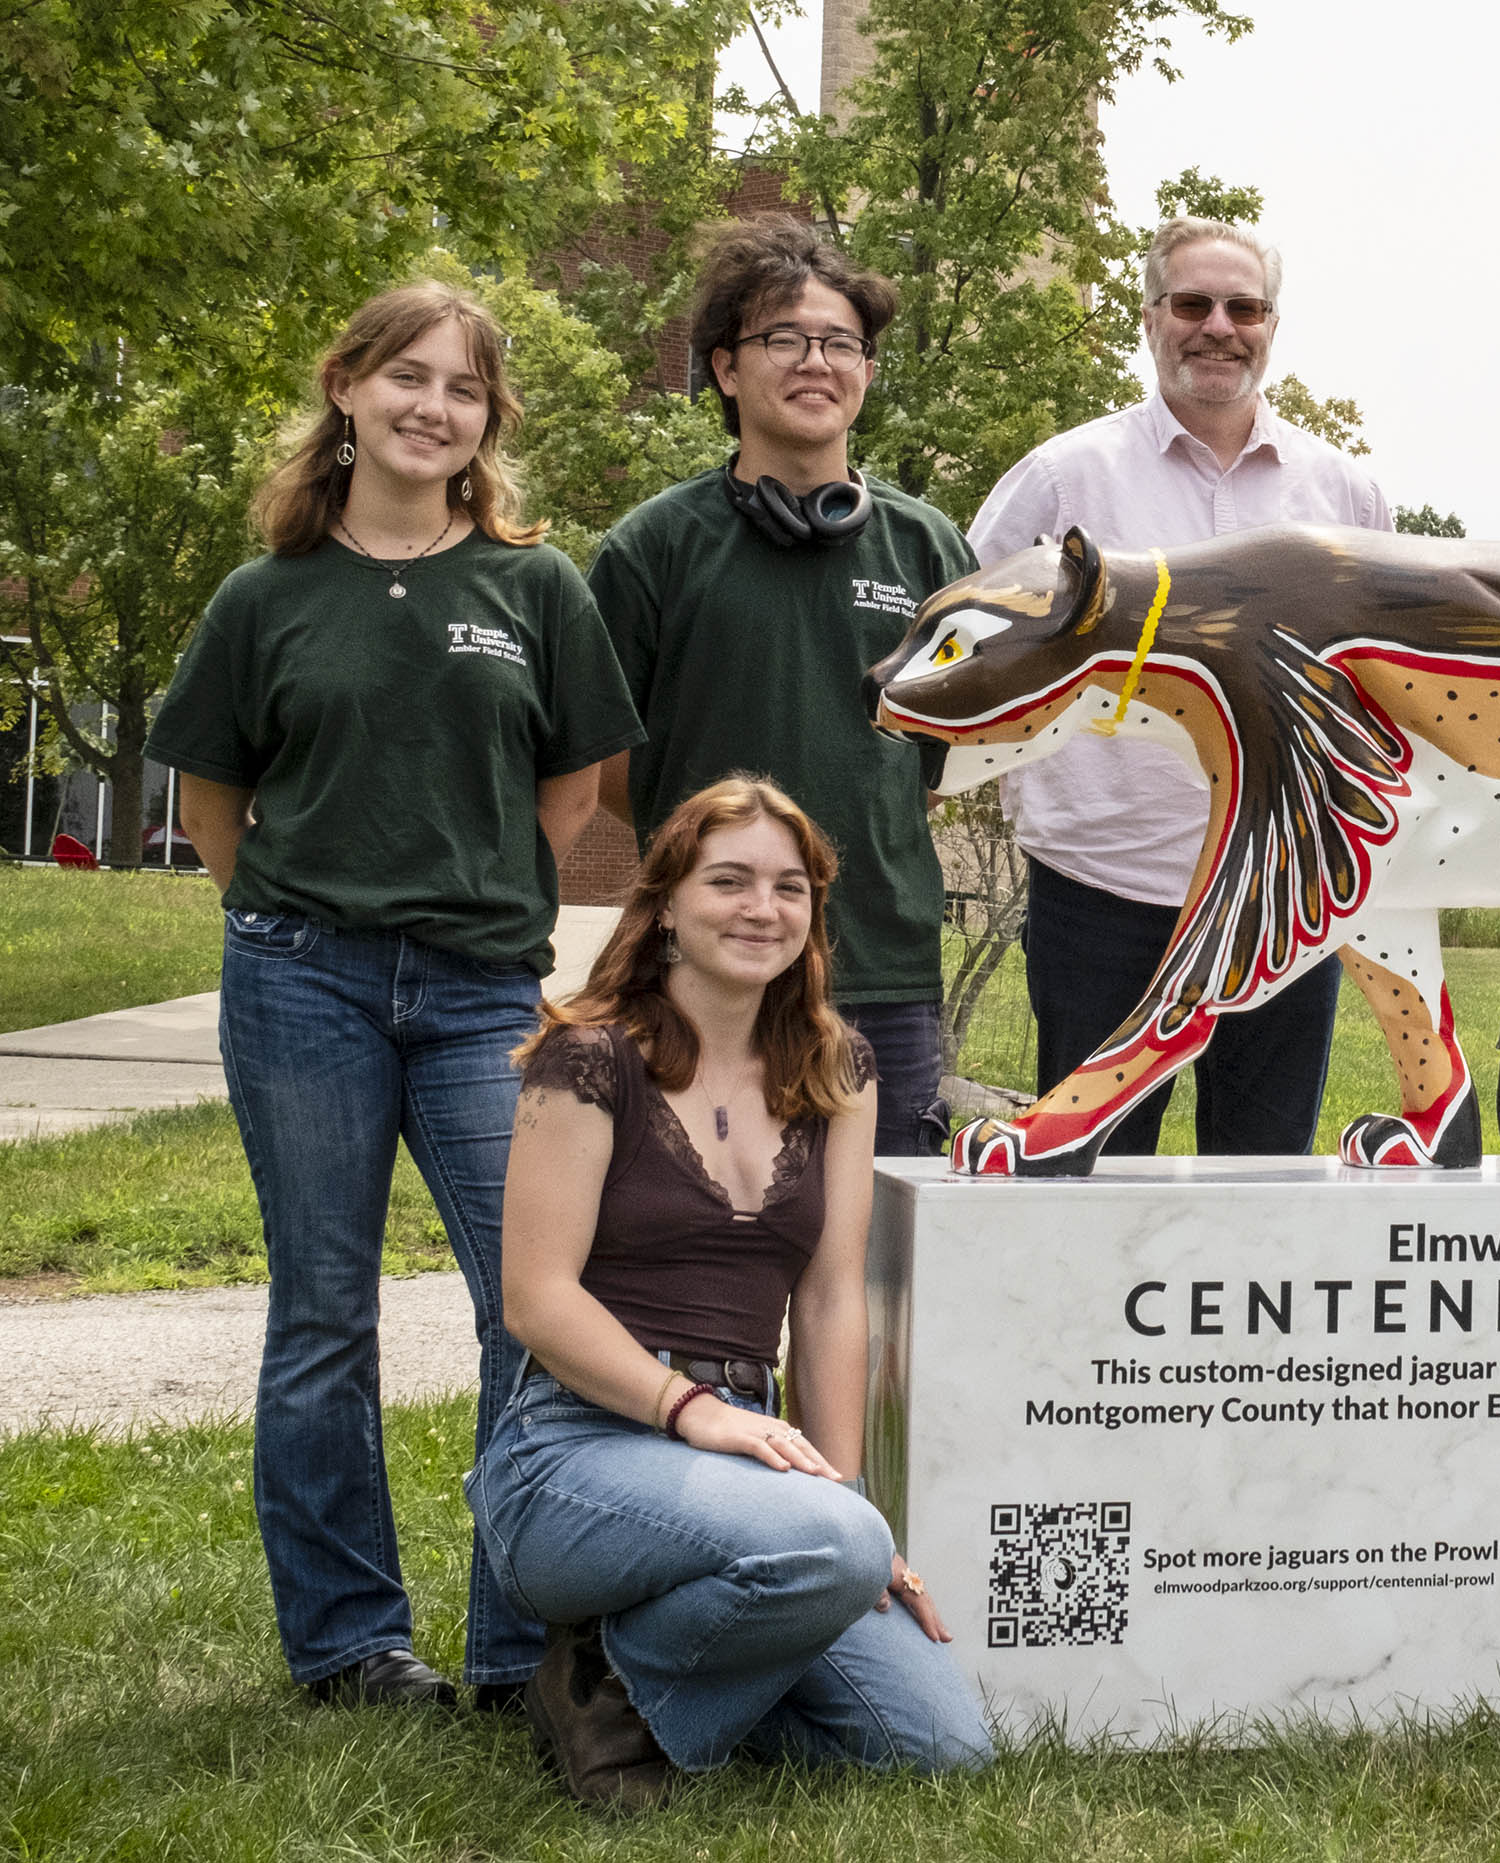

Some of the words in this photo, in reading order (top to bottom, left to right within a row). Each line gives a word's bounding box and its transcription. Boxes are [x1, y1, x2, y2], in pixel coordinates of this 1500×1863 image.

[871, 581, 906, 596] Temple
[853, 600, 881, 610] Ambler
[882, 603, 900, 613] Field
[872, 590, 919, 610] University
[470, 624, 509, 639] Temple
[448, 645, 481, 653] Ambler
[482, 646, 502, 657] Field
[471, 634, 523, 654] University
[1092, 1359, 1151, 1384] This
[1159, 1356, 1403, 1387] custom-designed
[1409, 1355, 1497, 1386] jaguar
[1026, 1399, 1213, 1430] Montgomery
[1222, 1398, 1325, 1427] County
[1332, 1396, 1389, 1421] that
[1398, 1395, 1480, 1420] honor
[1143, 1548, 1197, 1572] Spot
[1203, 1551, 1262, 1568] more
[1267, 1546, 1350, 1571] jaguars
[1356, 1548, 1384, 1564] on
[1390, 1543, 1427, 1563] the
[1154, 1572, 1495, 1595] elmwoodparkzoo.org/support/centennial-prowl
